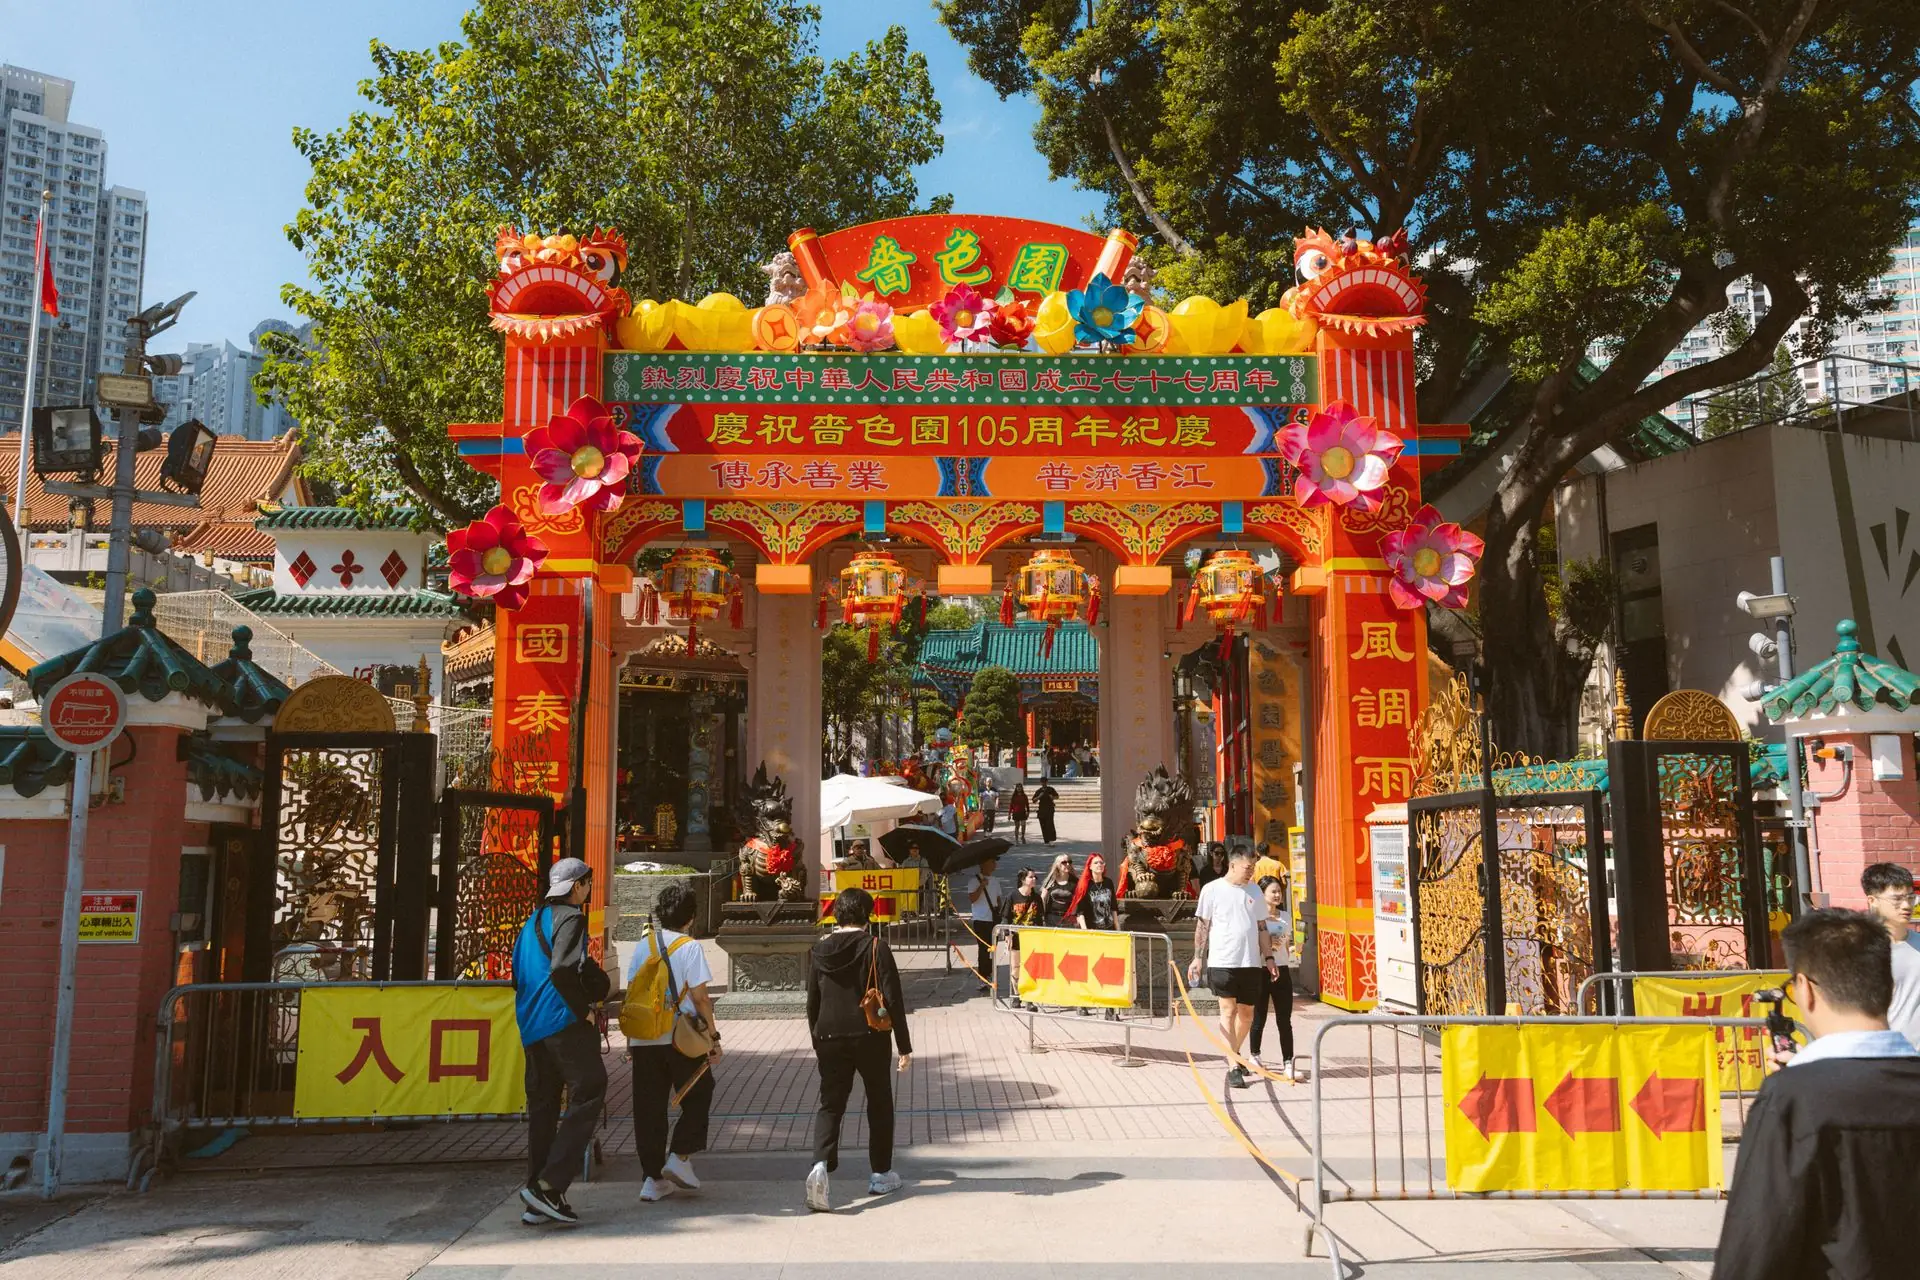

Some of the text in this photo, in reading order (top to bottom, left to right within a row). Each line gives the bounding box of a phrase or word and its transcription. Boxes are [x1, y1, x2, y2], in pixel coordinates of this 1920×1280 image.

[857, 227, 1070, 298] 嗇色園
[641, 366, 1279, 394] 熱烈慶祝中華人民共和國成立七十七周年
[710, 460, 890, 492] 傳承善業
[1035, 462, 1215, 492] 普濟香江
[1350, 622, 1417, 865] 風調雨
[862, 874, 893, 890] 出口
[93, 896, 112, 905] 注意
[80, 916, 132, 927] 心車輛出入
[335, 1017, 492, 1085] 入口
